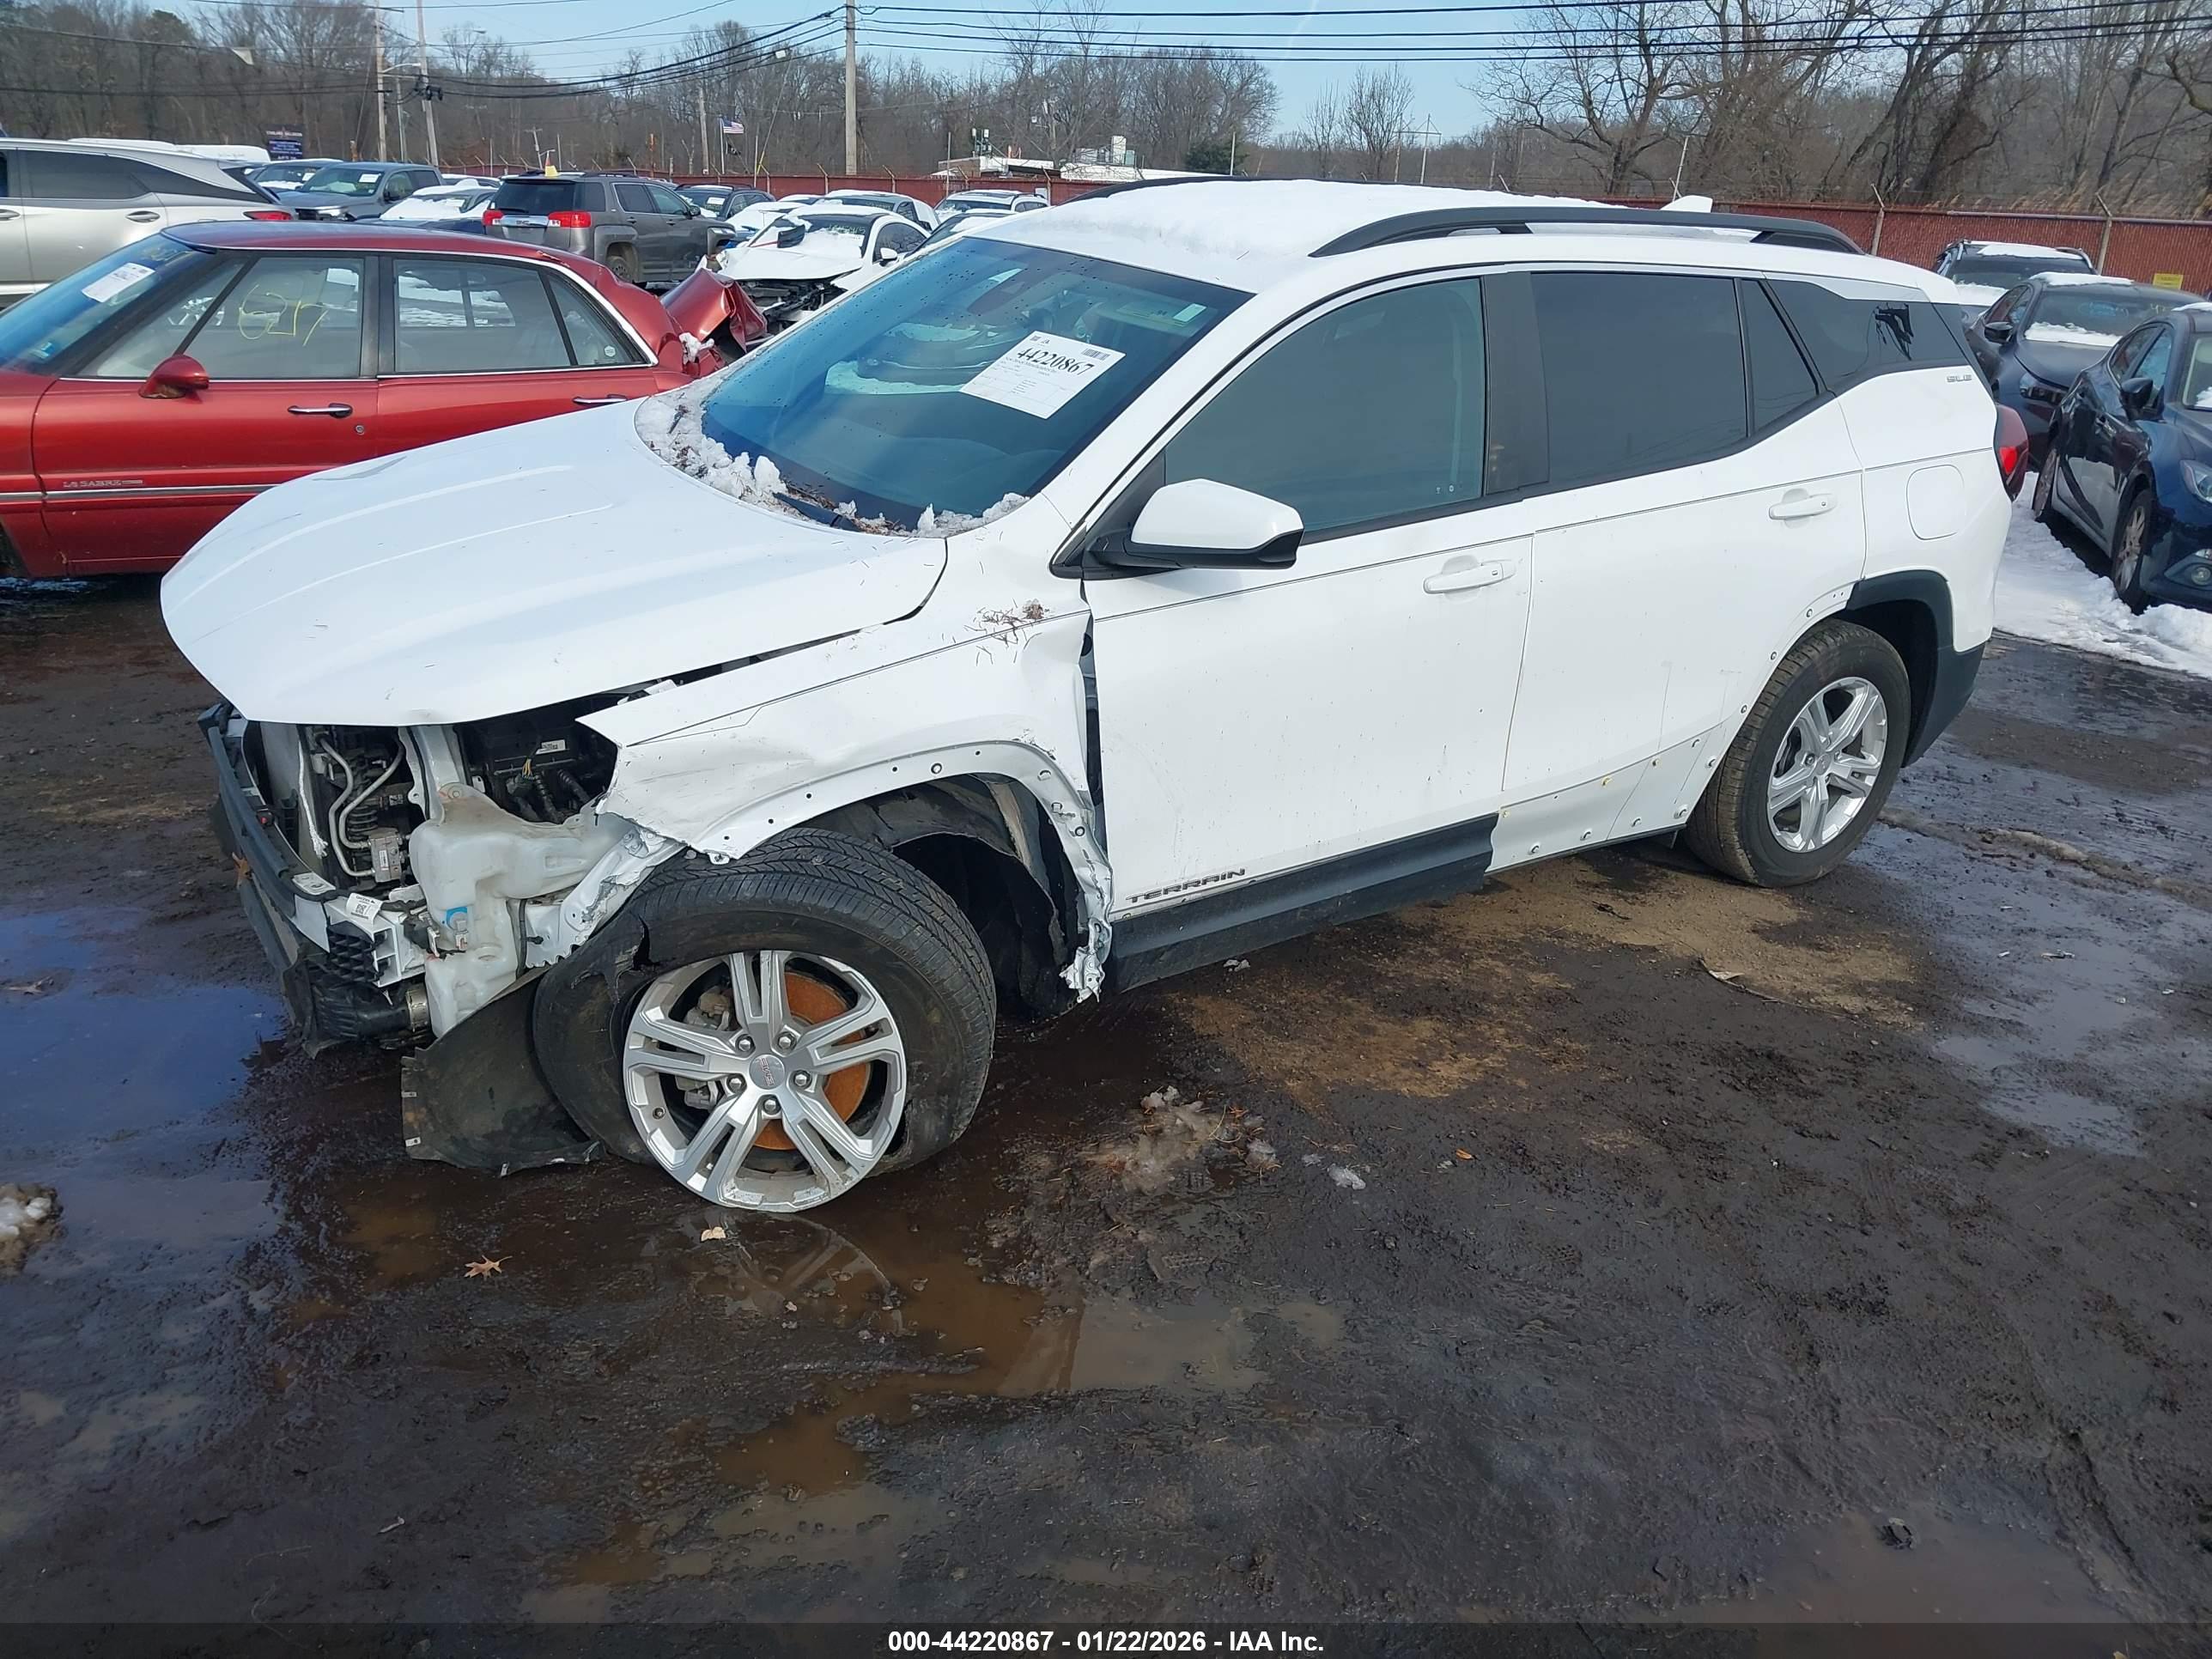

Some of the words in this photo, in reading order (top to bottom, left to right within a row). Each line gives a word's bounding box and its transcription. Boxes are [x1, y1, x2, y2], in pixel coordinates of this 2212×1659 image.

[1017, 347, 1096, 376] 44220867
[1946, 374, 1972, 383] SLE
[1125, 867, 1246, 903] TERRAIN
[759, 1057, 775, 1086] GMC
